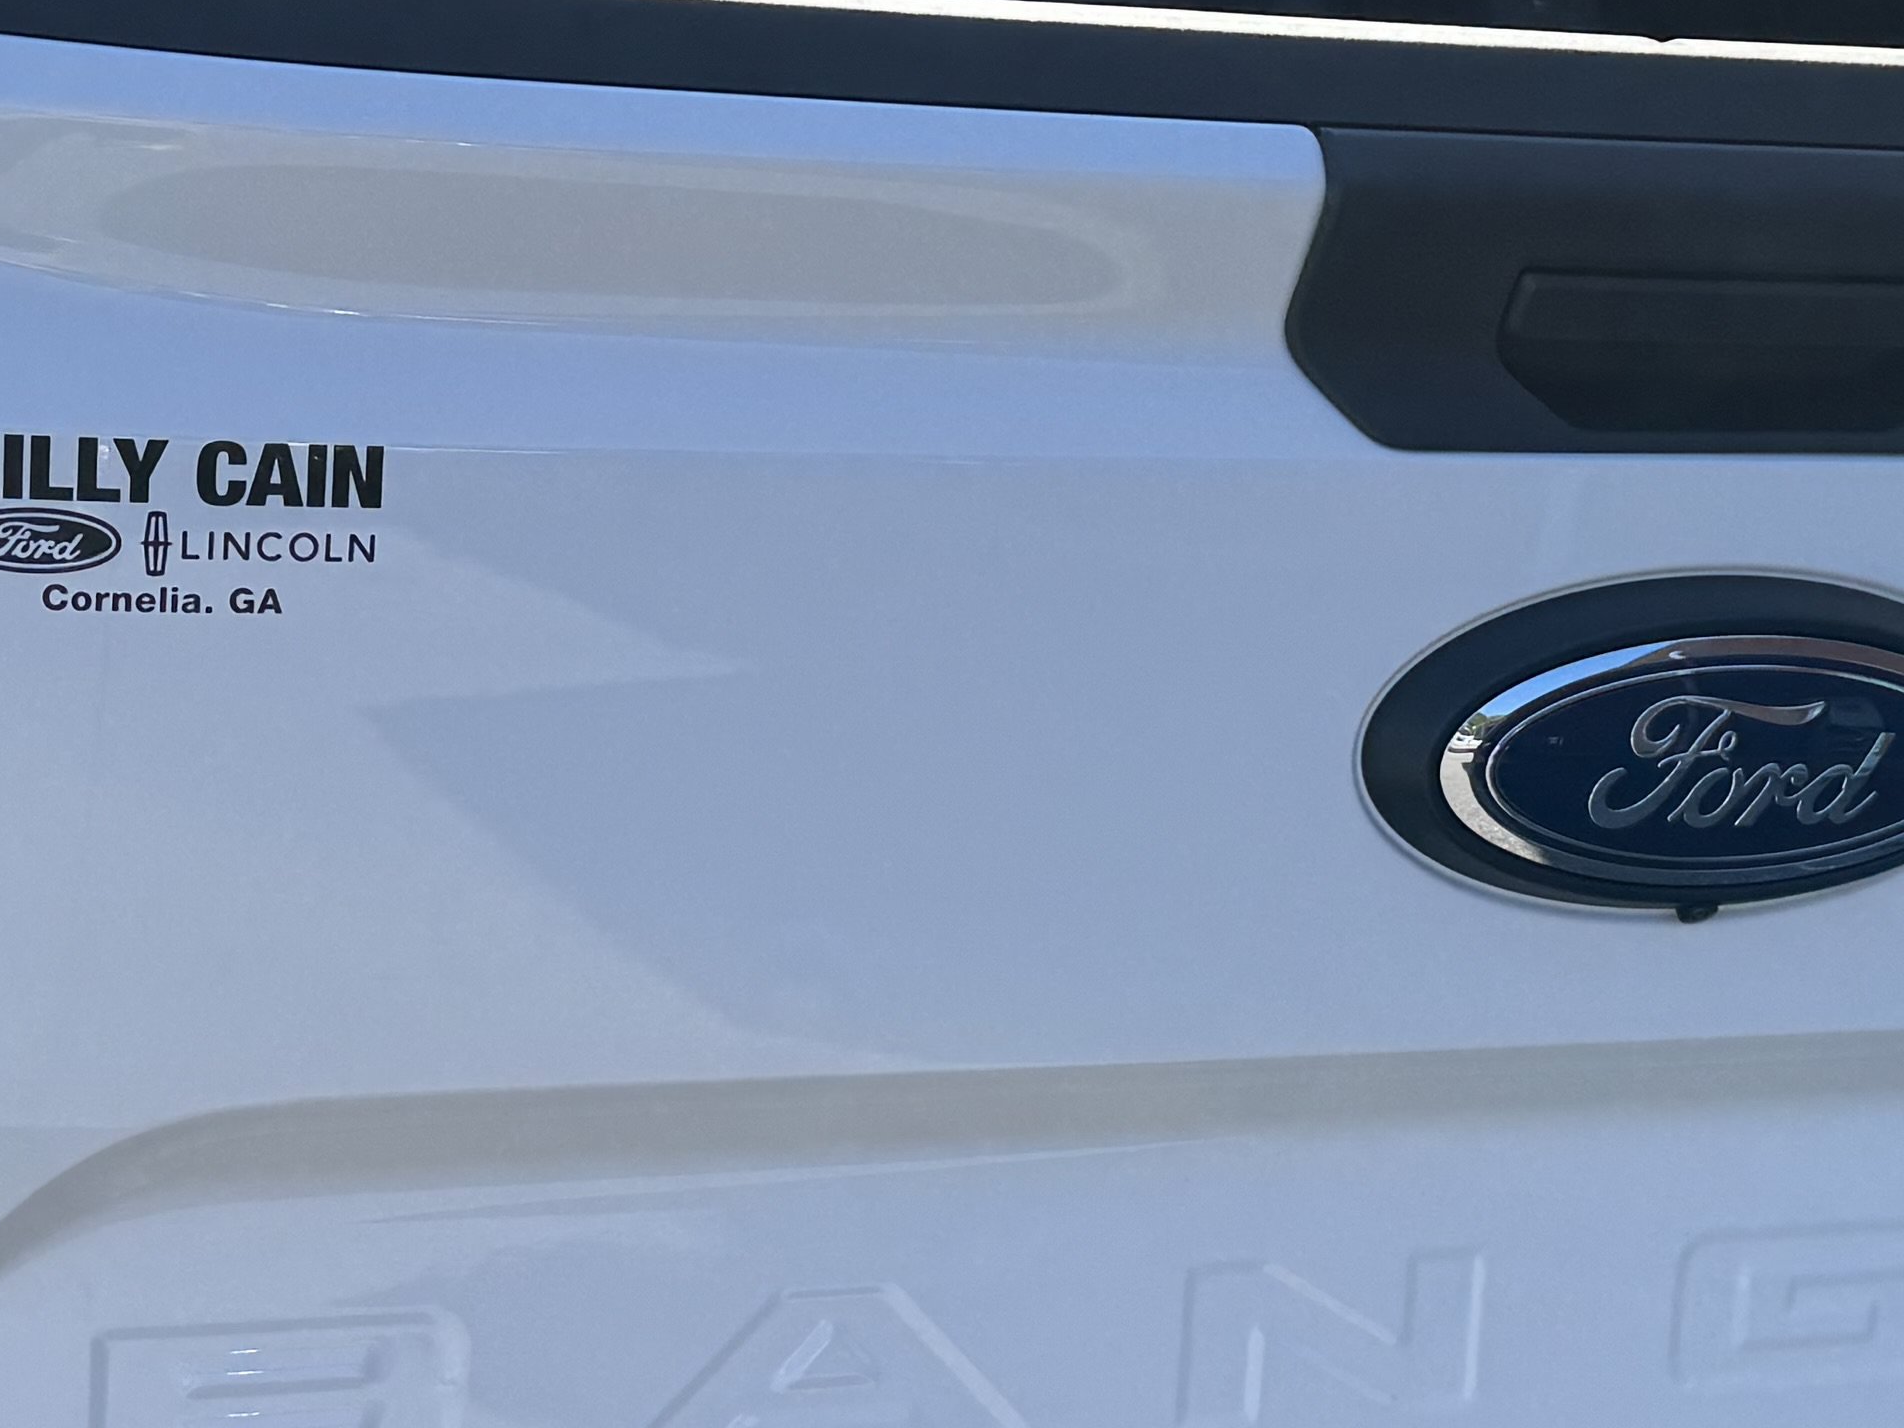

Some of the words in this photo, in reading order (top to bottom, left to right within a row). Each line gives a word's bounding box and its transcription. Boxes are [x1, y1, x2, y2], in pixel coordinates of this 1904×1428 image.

[197, 440, 384, 508] CAIN
[181, 531, 376, 563] LINCOLN
[229, 588, 282, 614] GA
[1588, 695, 1896, 828] Ford
